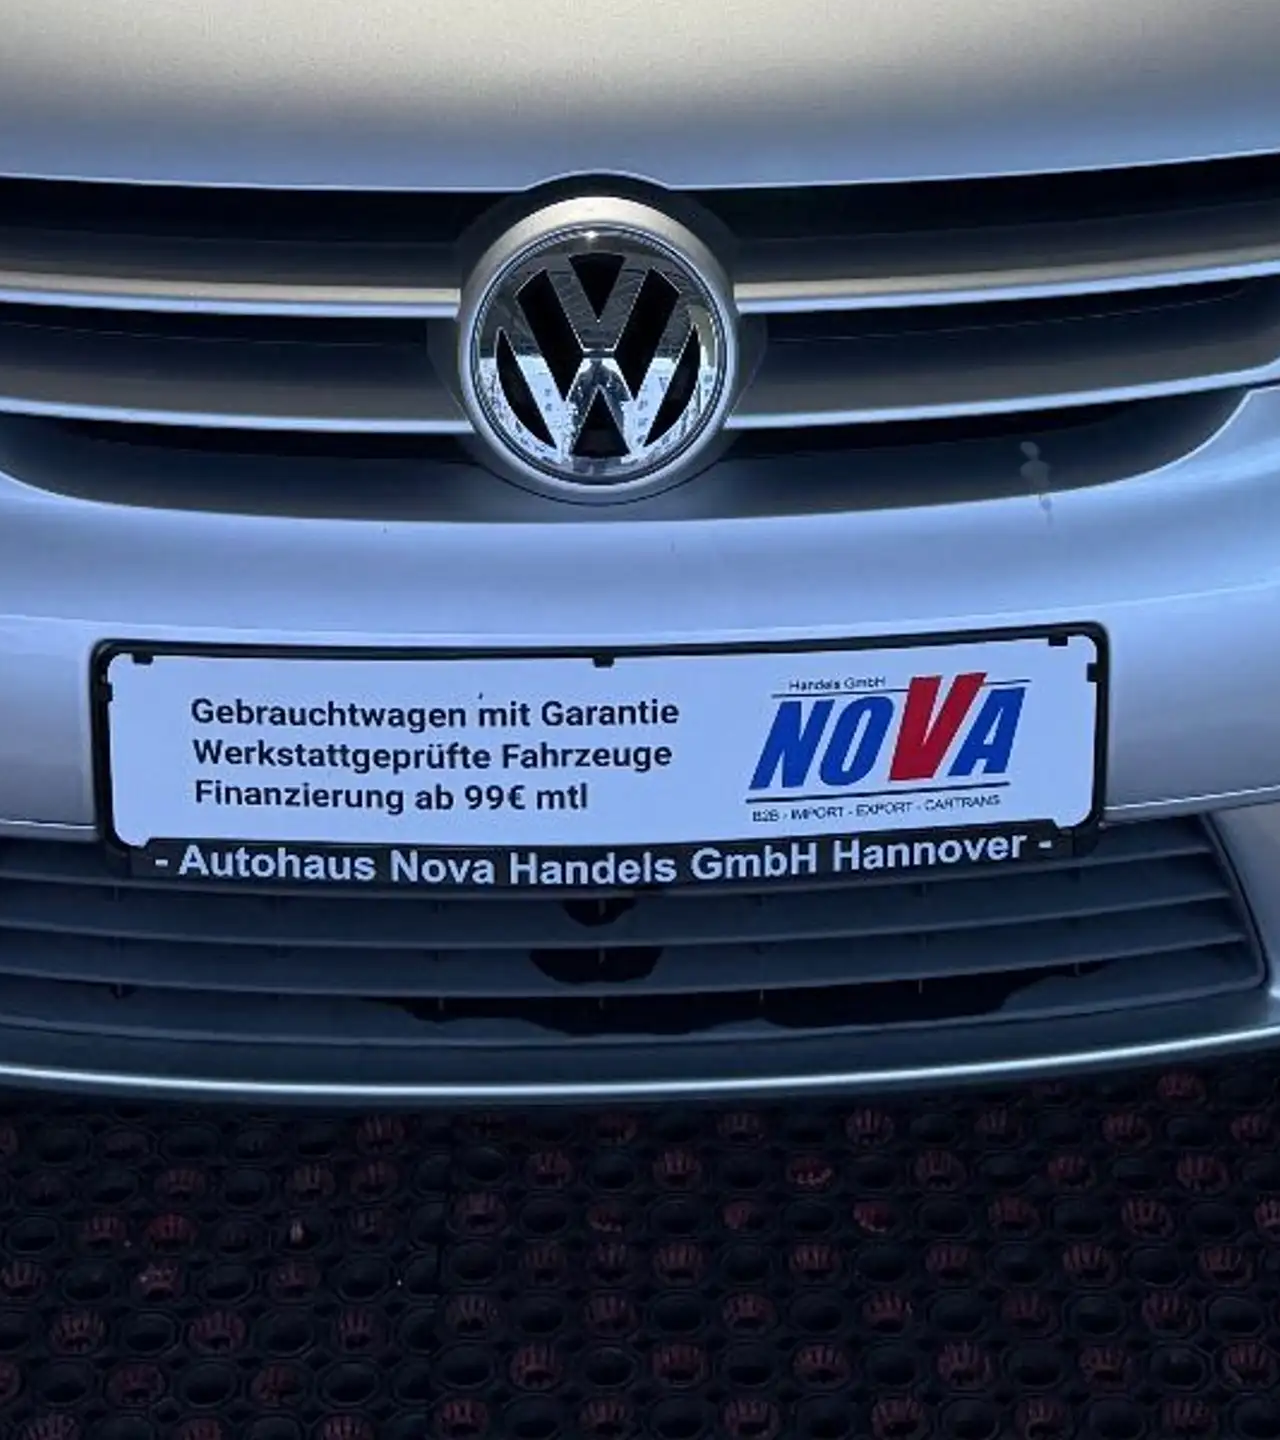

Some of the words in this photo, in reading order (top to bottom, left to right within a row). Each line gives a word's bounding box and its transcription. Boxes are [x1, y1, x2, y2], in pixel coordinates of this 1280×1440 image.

[788, 678, 841, 691] Handels
[843, 676, 886, 690] GmbH
[191, 698, 467, 734] Gebrauchtwagen
[478, 700, 531, 727] mit
[541, 699, 680, 726] Garantie
[748, 672, 1026, 790] NOVA
[193, 739, 492, 776] Werkstattgeprüfte
[502, 742, 672, 773] Fahrzeuge
[195, 779, 404, 816] Finanzierung
[414, 783, 454, 811] ab
[464, 785, 526, 810] 99€
[536, 782, 588, 810] mtl
[791, 806, 845, 821] IMPORT
[856, 802, 913, 817] EXPORT
[924, 794, 1001, 811] CARTRANS
[178, 844, 376, 882] Autohaus
[390, 849, 495, 884] Nova
[510, 851, 677, 885] Handels
[691, 842, 817, 881] GmbH
[832, 834, 1027, 873] Hannover
